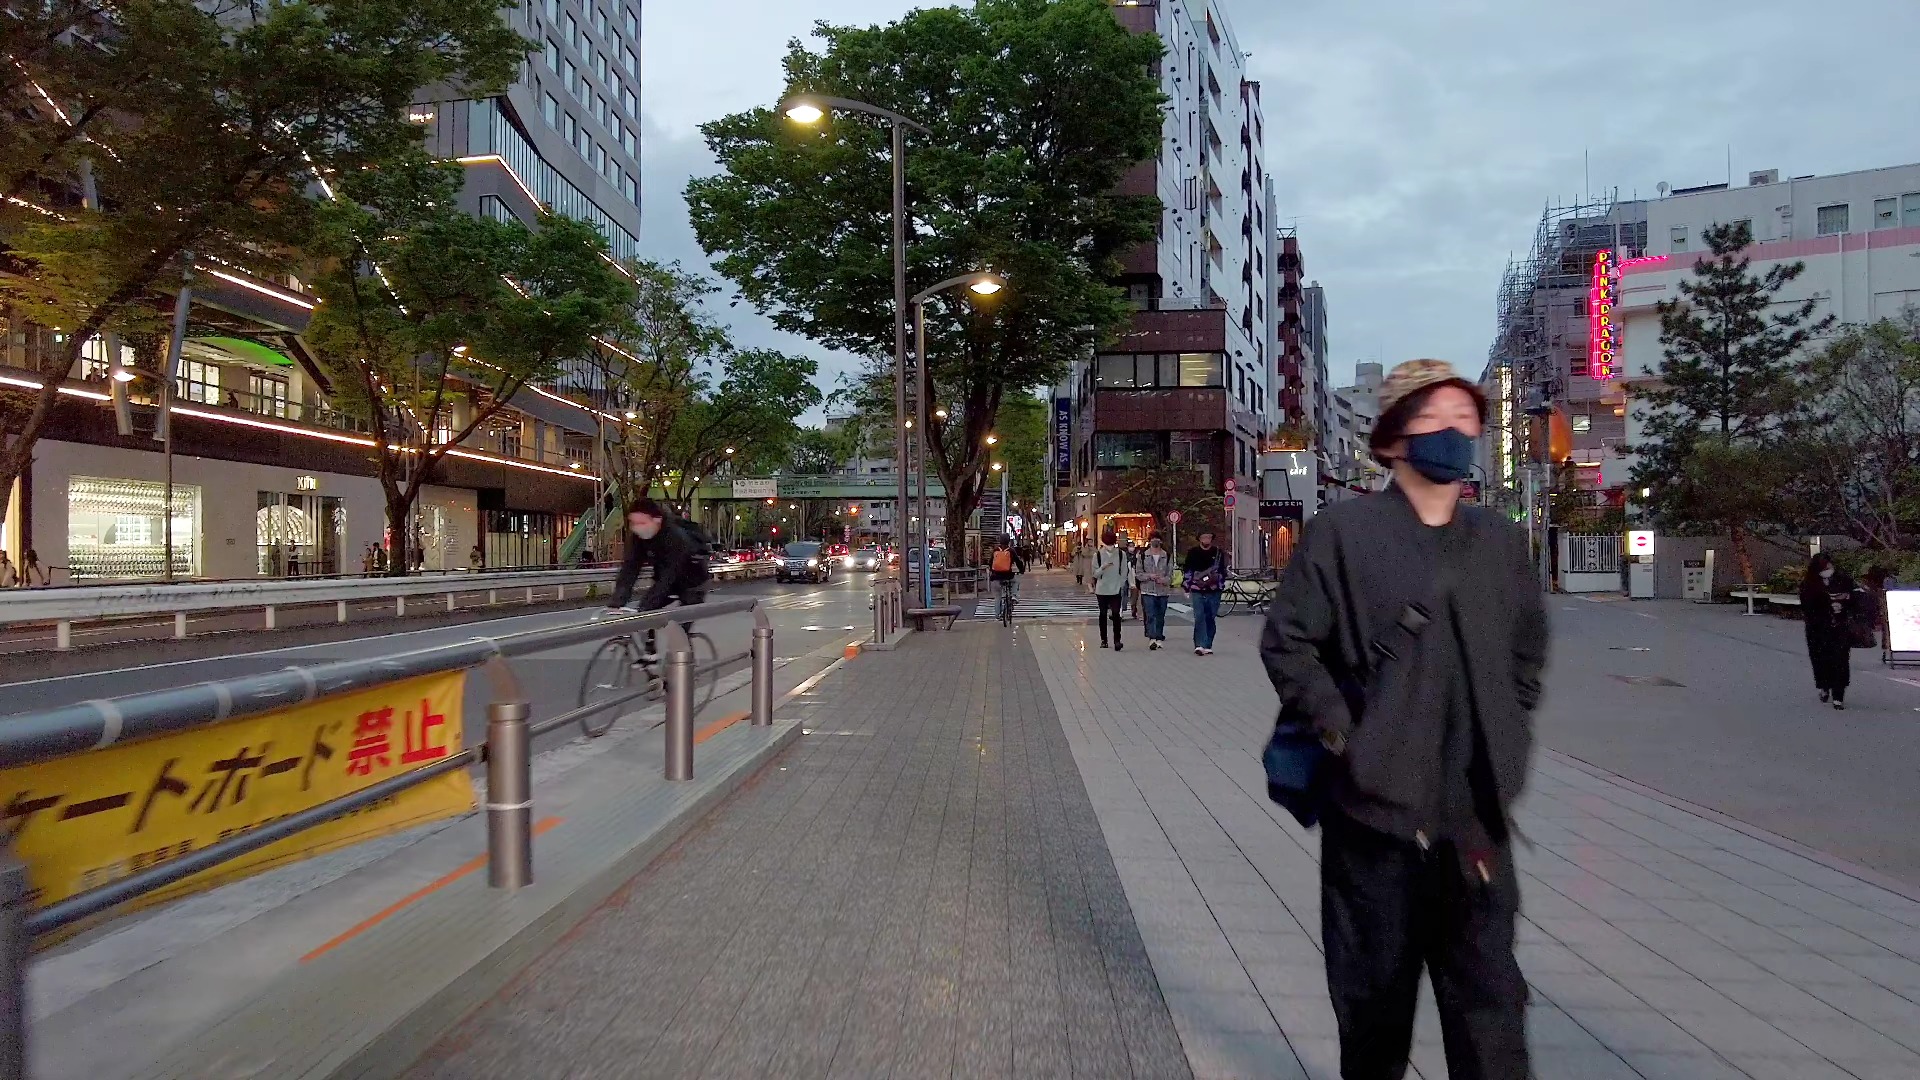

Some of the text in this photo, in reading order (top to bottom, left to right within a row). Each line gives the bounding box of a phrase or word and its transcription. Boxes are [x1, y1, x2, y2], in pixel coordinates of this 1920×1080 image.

[1599, 252, 1612, 376] PINK DRAGON
[1059, 410, 1068, 463] AS KNOW AS
[297, 475, 316, 490] KITH
